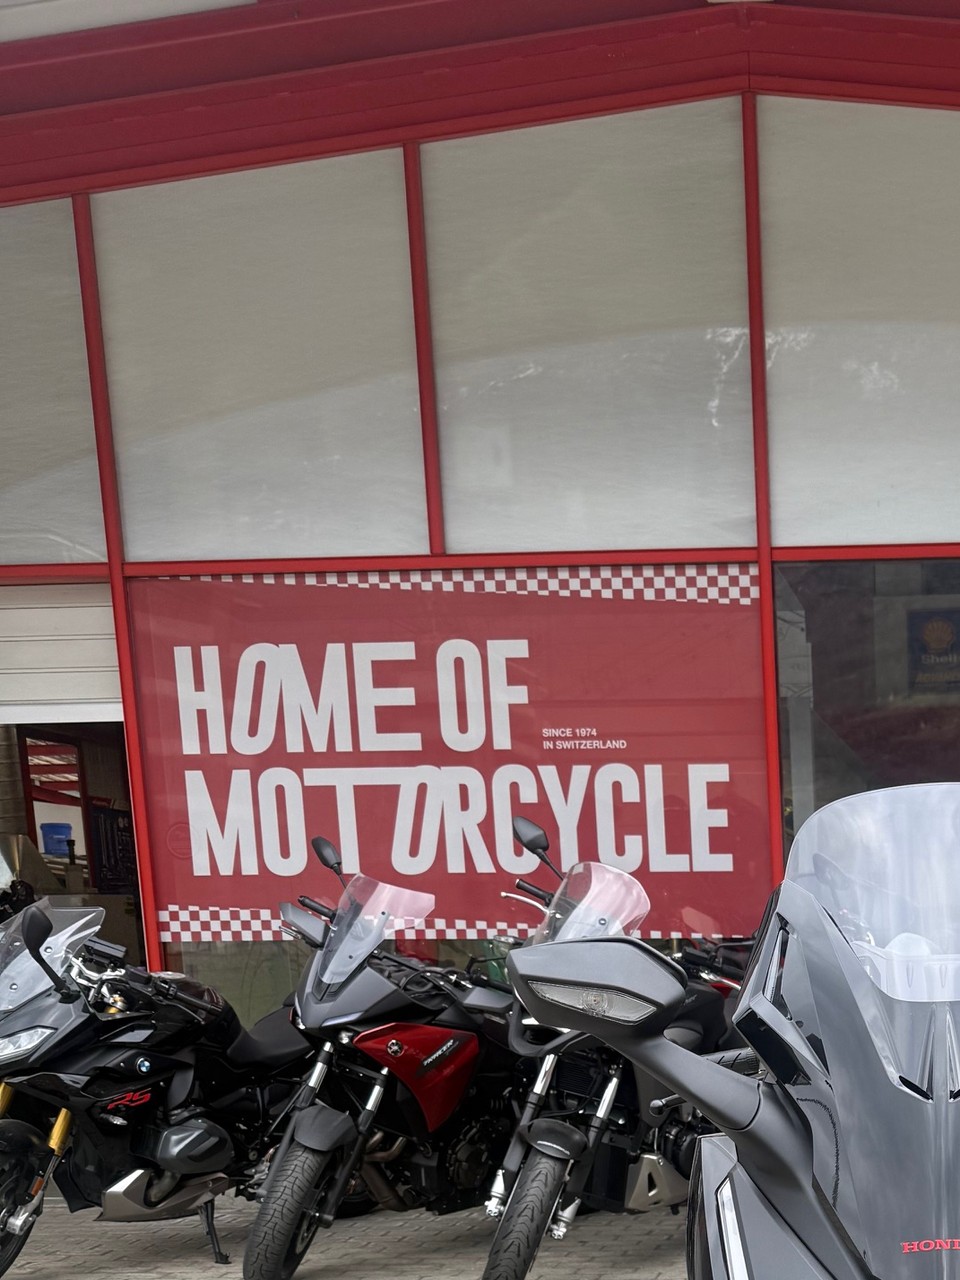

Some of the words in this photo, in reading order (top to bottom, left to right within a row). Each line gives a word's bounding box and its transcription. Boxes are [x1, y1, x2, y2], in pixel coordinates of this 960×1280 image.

[173, 641, 422, 755] HOME
[435, 638, 530, 751] OF
[542, 728, 573, 737] SINCE
[575, 728, 597, 737] 1974
[543, 741, 553, 749] IN
[555, 740, 627, 749] SWITZERLAND
[184, 763, 734, 877] MOTORCYCLE
[106, 1087, 152, 1110] RS
